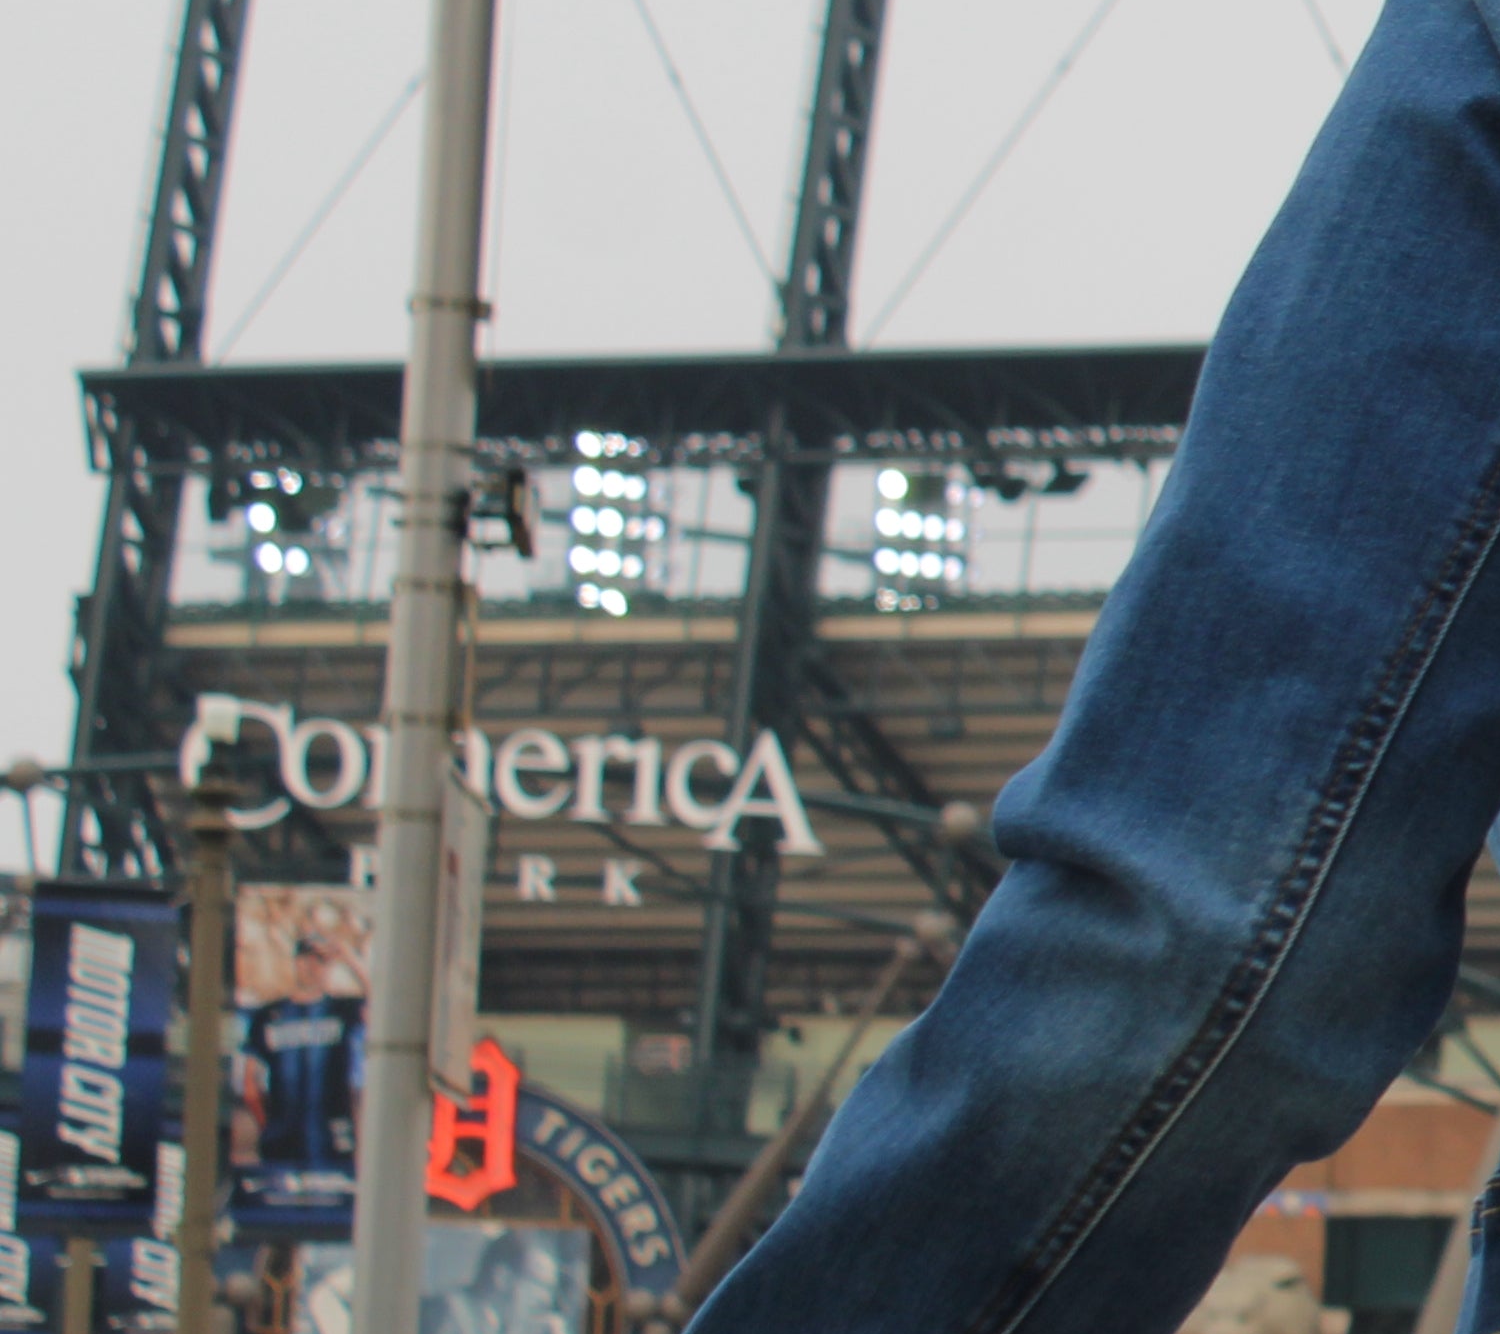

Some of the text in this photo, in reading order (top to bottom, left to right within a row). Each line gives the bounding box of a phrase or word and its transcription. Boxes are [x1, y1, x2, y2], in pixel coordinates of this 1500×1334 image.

[349, 844, 643, 908] PRK
[63, 921, 135, 1069] MOTOR
[57, 1062, 125, 1165] CITY
[533, 1107, 670, 1267] TIGERS
